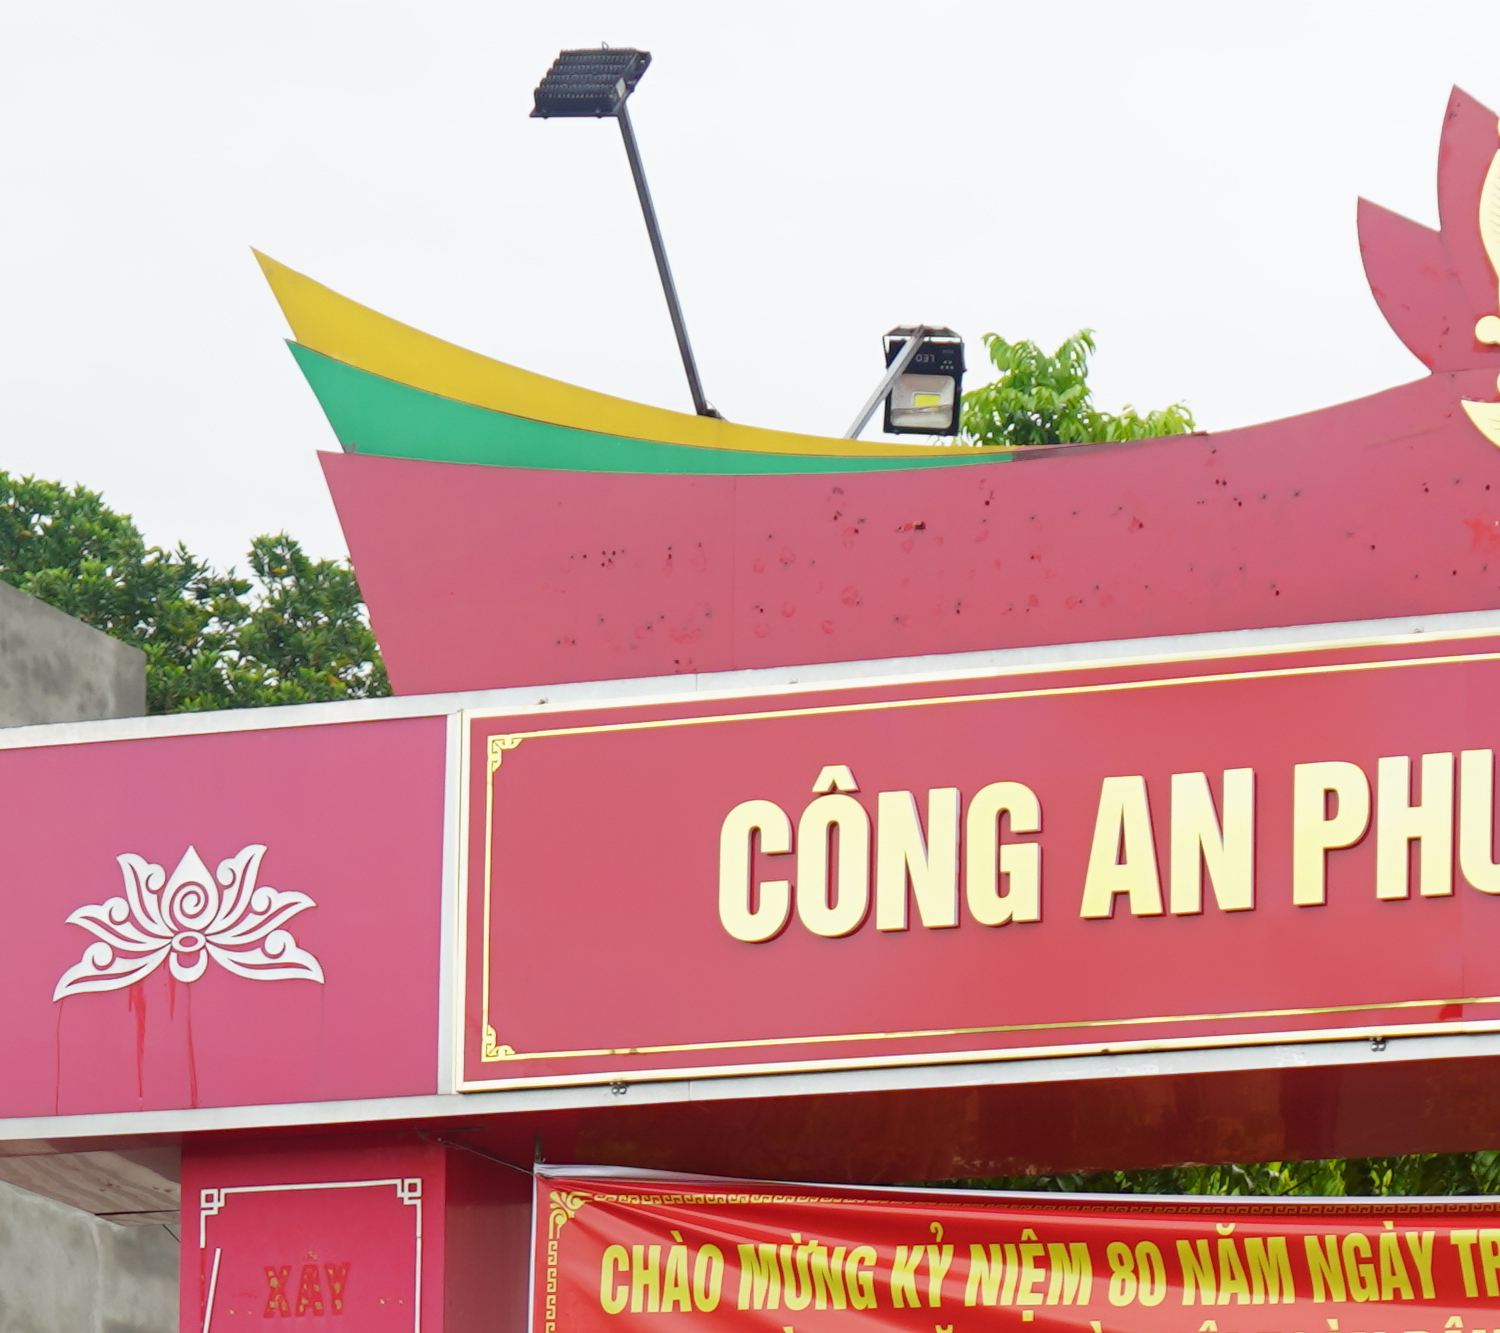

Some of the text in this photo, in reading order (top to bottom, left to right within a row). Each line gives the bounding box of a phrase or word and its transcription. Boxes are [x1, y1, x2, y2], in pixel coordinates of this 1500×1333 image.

[718, 765, 1042, 943] CÔNG
[1079, 768, 1256, 920] AN
[263, 1250, 350, 1318] XÂY
[600, 1230, 726, 1315] CHÀO
[737, 1233, 878, 1313] MỪNG
[890, 1221, 956, 1311] KỶ
[964, 1228, 1096, 1322] NIỆM
[1106, 1240, 1167, 1308] 80
[1181, 1223, 1296, 1306] NĂM
[1304, 1220, 1438, 1304] NGÀY
